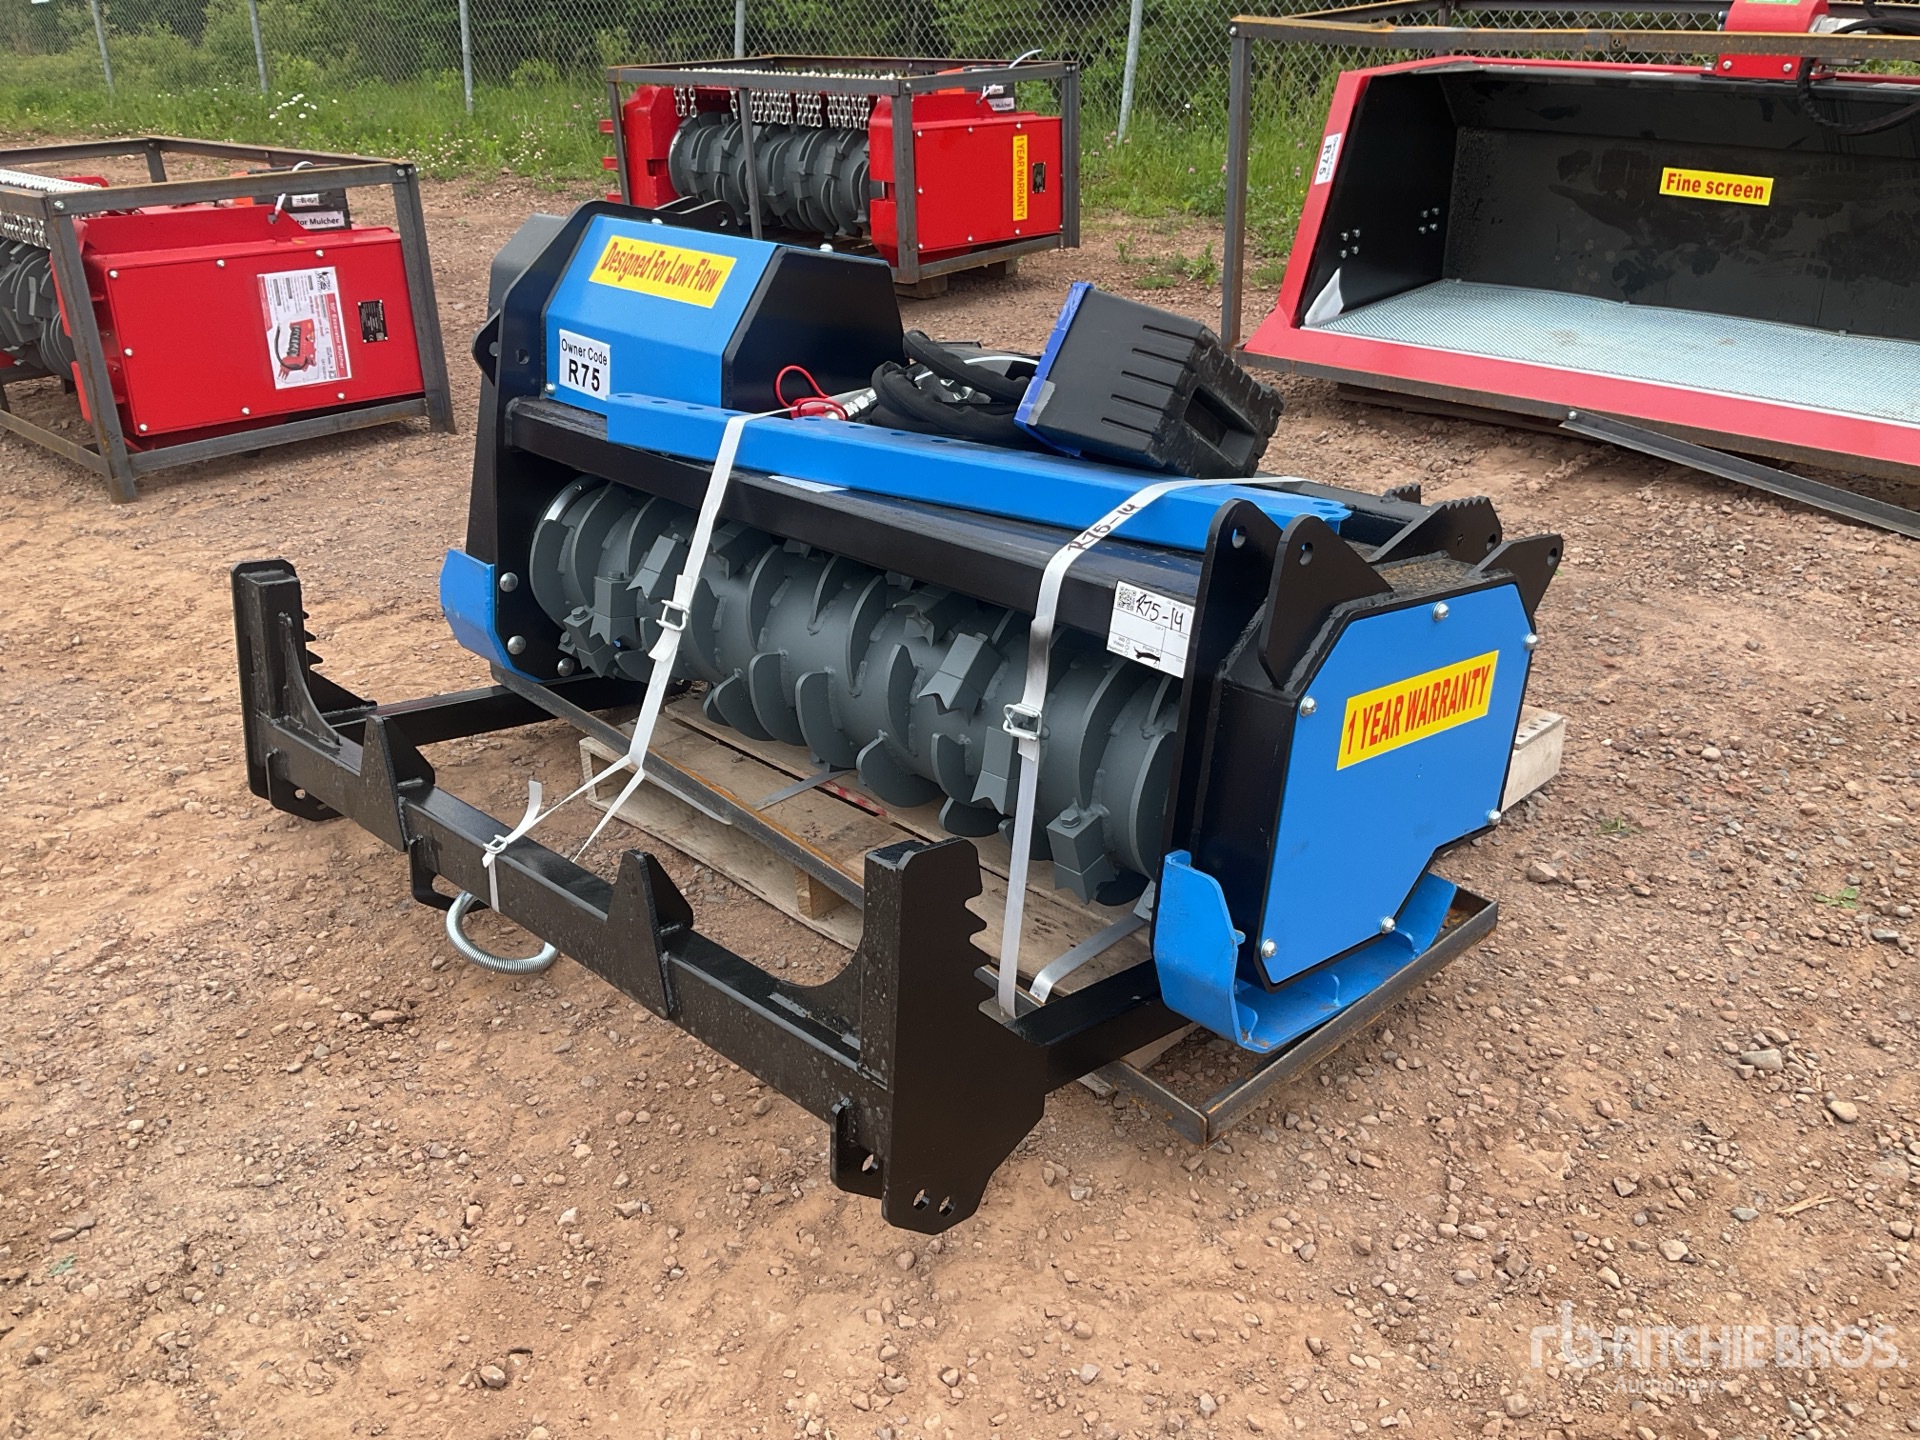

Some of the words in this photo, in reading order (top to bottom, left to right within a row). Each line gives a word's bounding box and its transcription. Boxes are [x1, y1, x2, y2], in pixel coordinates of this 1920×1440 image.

[1017, 142, 1025, 168] YEAR
[1319, 144, 1332, 175] R75
[1017, 168, 1025, 217] WARRANTY
[1666, 172, 1701, 193] Fine
[1705, 180, 1764, 199] screen
[310, 217, 339, 225] Mulcher
[600, 241, 657, 282] Designed
[653, 250, 672, 282] For
[665, 254, 695, 287] Low
[688, 258, 723, 292] Flow
[561, 338, 586, 358] Owner
[587, 347, 607, 366] Code
[568, 358, 600, 392] R75
[1067, 504, 1143, 551] R75-14
[1136, 594, 1184, 632] R75-14
[1347, 710, 1357, 755] 1
[1360, 694, 1404, 750] YEAR
[1404, 664, 1491, 733] WARRANTY
